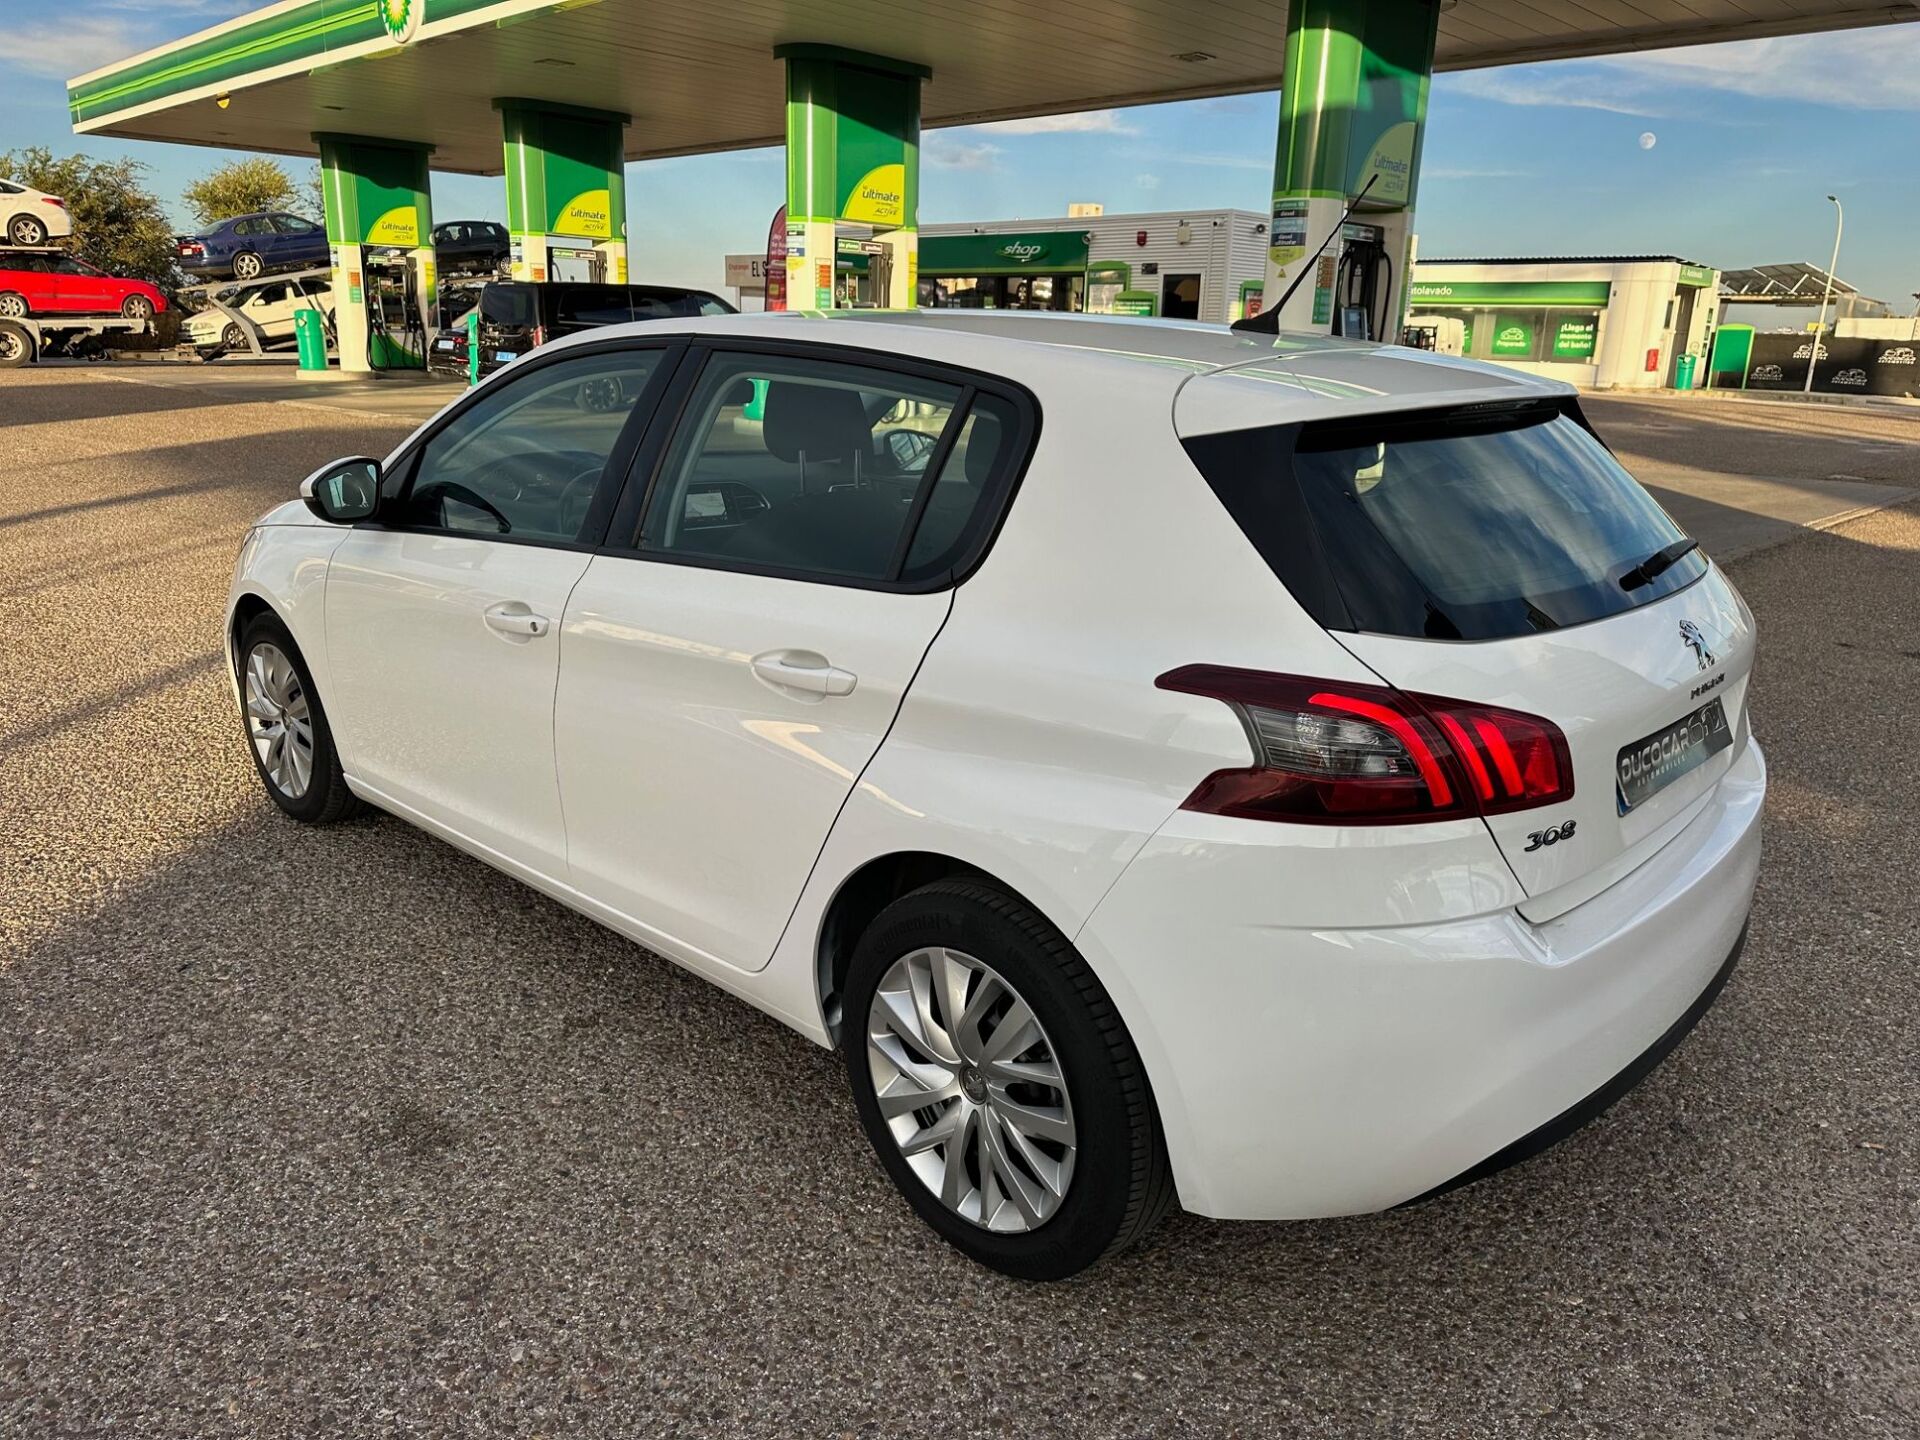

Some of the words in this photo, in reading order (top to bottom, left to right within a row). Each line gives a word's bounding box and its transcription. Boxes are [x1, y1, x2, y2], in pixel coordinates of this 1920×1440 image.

[862, 189, 900, 202] ultimate
[571, 209, 606, 219] ultimate
[1004, 241, 1041, 258] shop
[1621, 727, 1690, 783] DUCOCAR
[1524, 820, 1576, 852] 308
